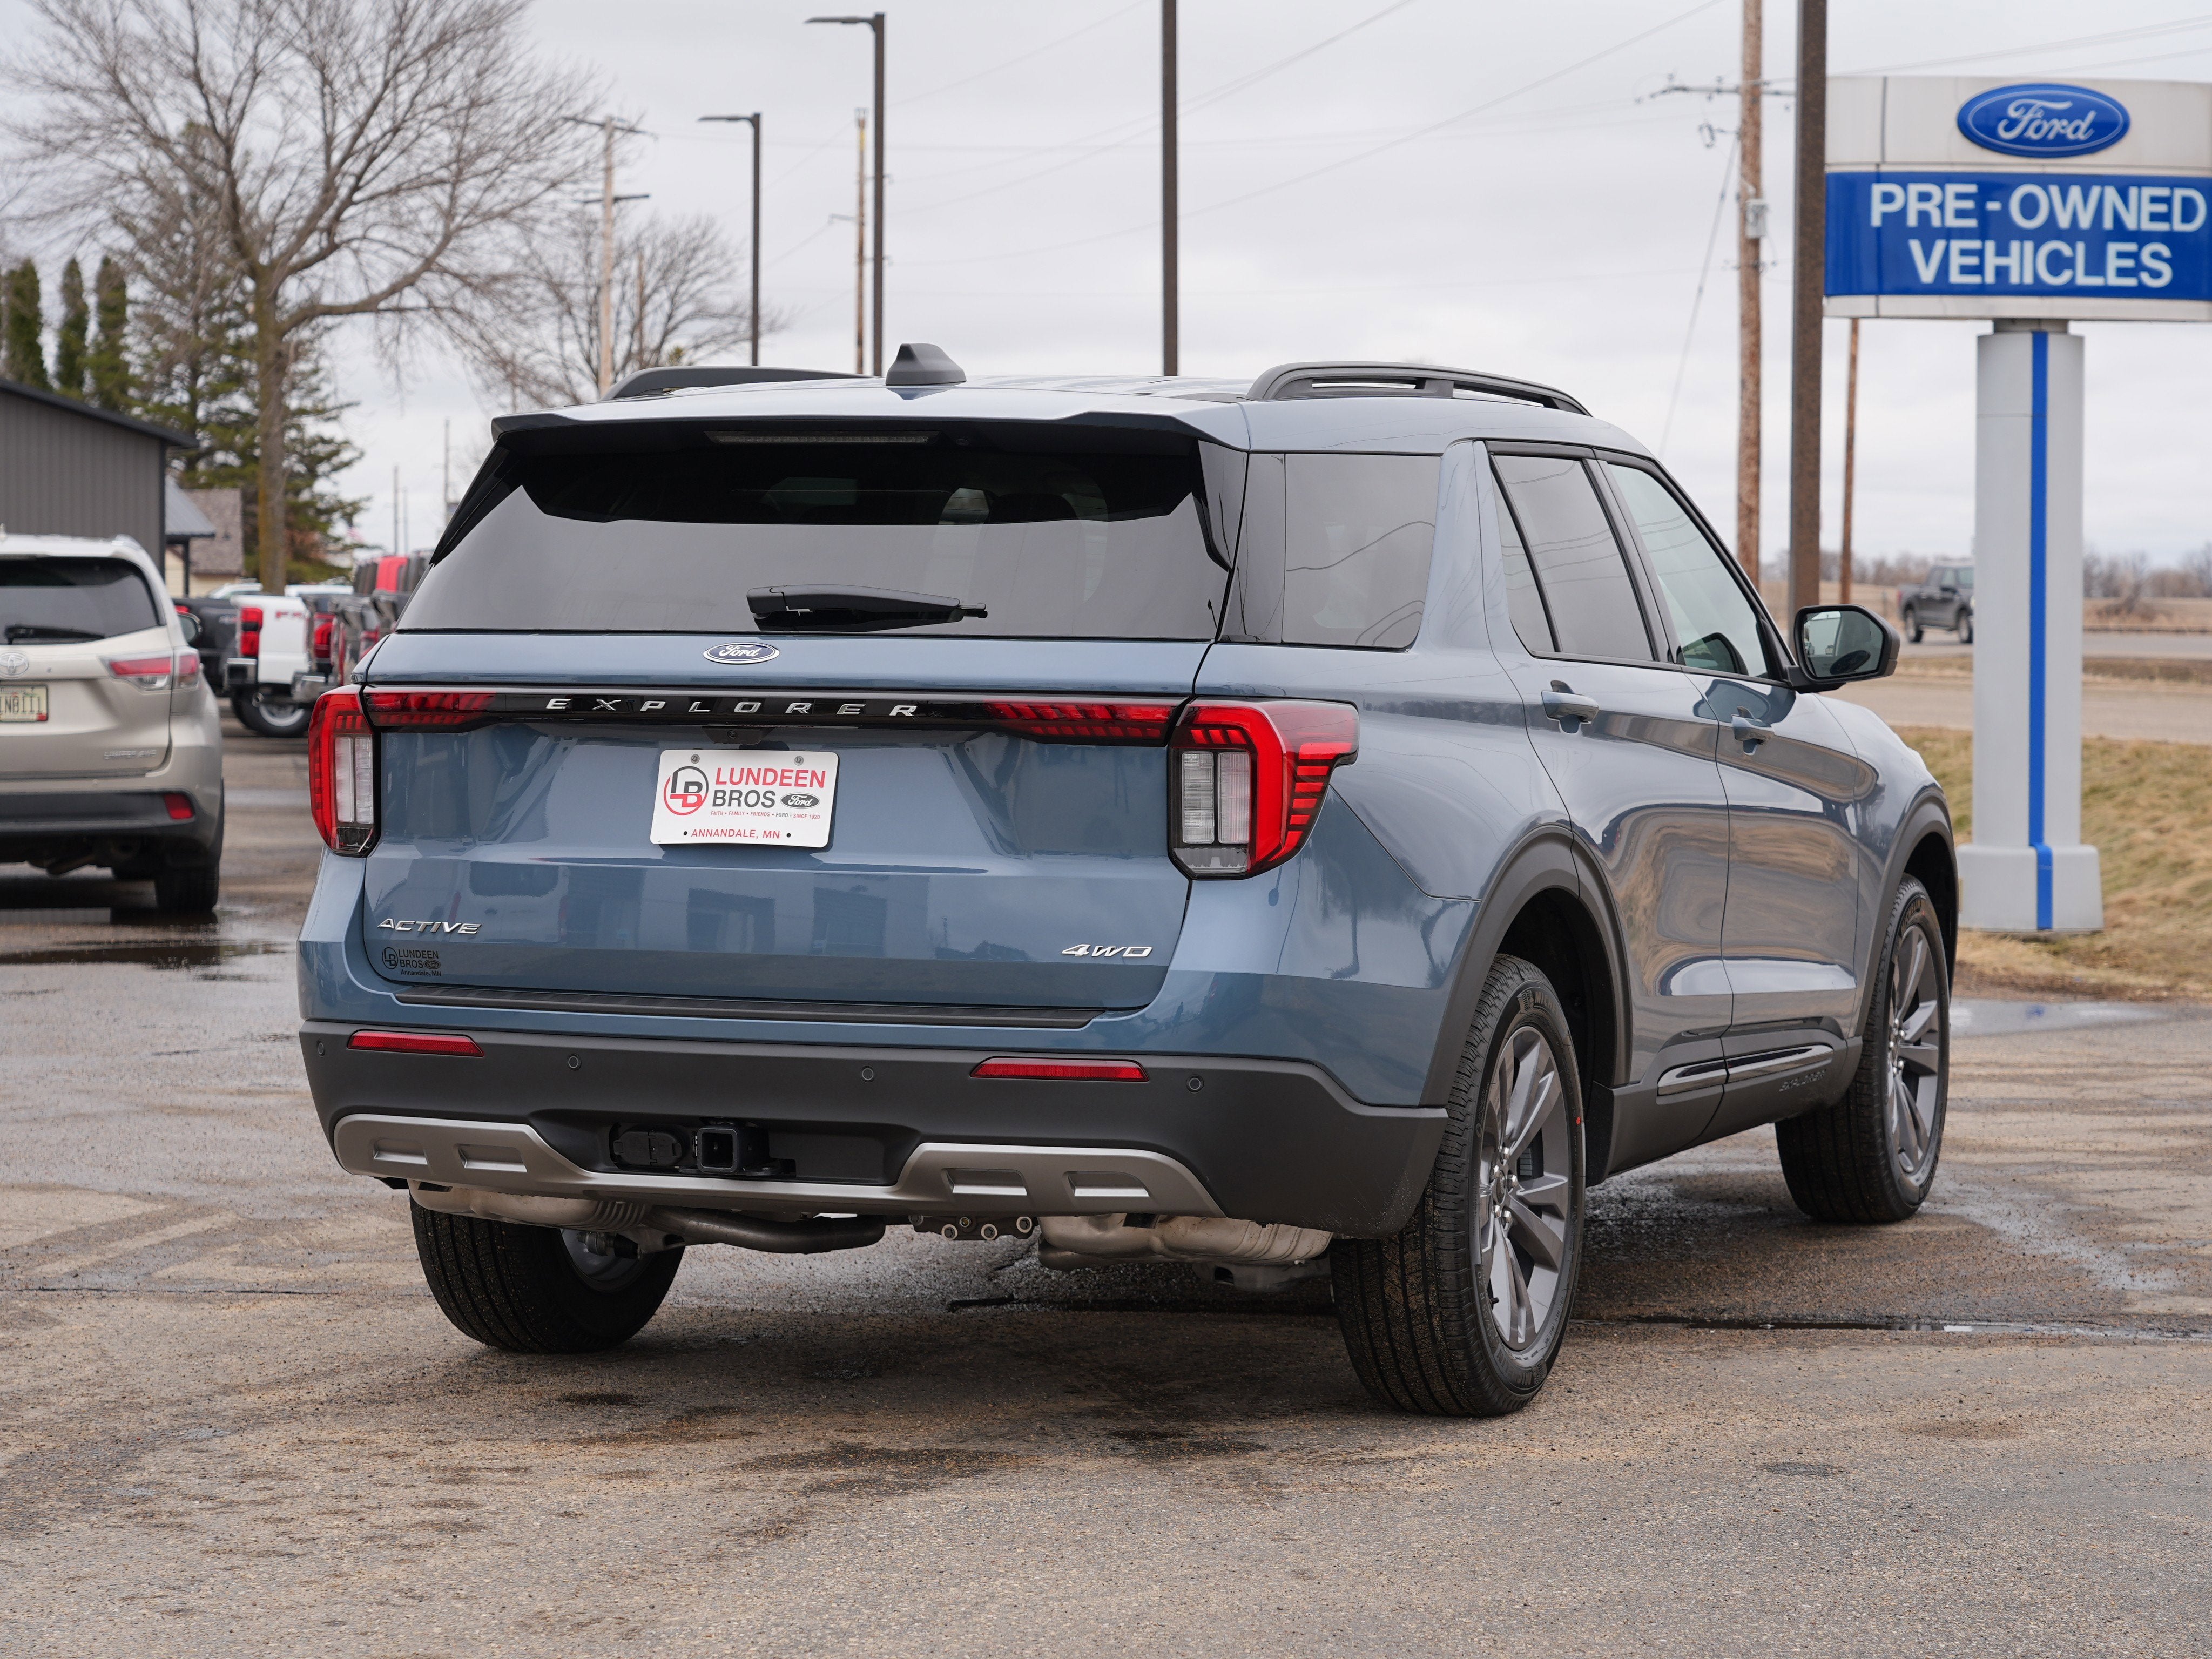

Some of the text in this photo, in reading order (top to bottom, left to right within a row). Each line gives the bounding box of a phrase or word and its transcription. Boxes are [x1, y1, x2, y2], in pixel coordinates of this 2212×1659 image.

[1998, 98, 2097, 140] Ford
[1871, 183, 2207, 232] PRE-OWNED
[1908, 239, 2173, 288] VEHICLES
[719, 644, 762, 657] Ford
[545, 698, 918, 717] EXPLORER
[716, 767, 826, 788] LUNDEEN
[712, 790, 813, 808] BROS Ford
[691, 829, 780, 839] ANNANDALE, MN
[377, 918, 482, 934] ACTIVE
[399, 949, 439, 959] LUNDEEN
[1061, 943, 1153, 957] 4WD
[400, 960, 423, 968] BROS
